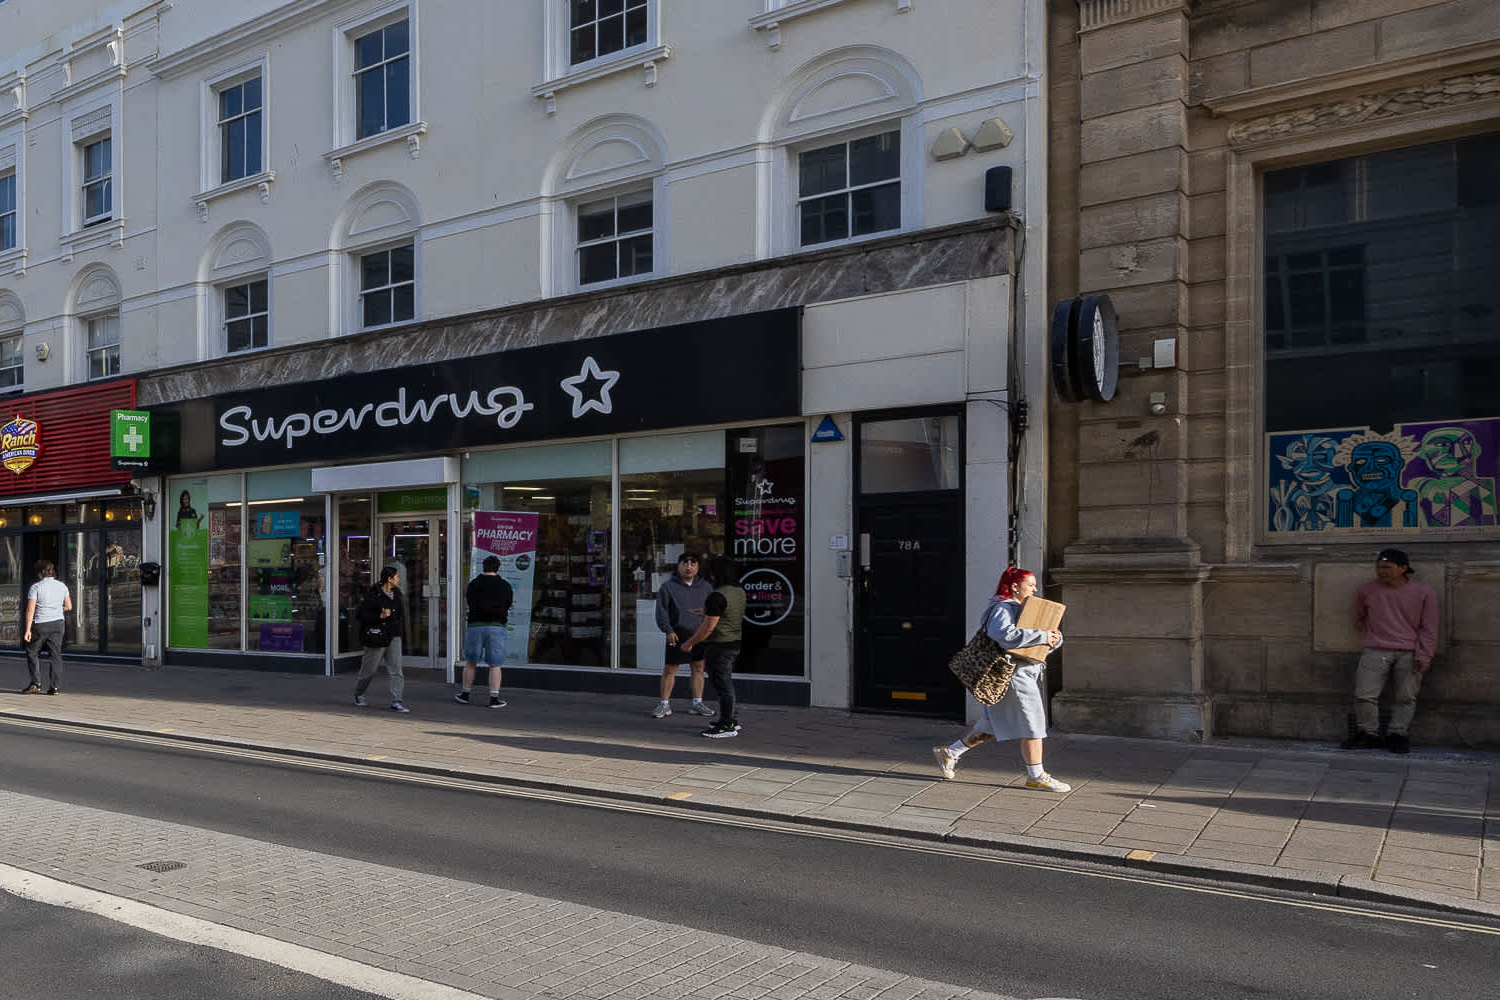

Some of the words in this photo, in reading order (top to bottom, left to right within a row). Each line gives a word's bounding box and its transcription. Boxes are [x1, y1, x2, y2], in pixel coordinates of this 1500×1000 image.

[117, 412, 149, 423] Pharmacy
[219, 386, 534, 449] Superdrug
[1, 430, 36, 450] Ranch
[2, 449, 23, 460] AMERICAN
[734, 497, 796, 505] Superdrug
[734, 517, 797, 535] save
[476, 529, 533, 541] PHARMACY
[734, 537, 796, 555] more
[744, 582, 773, 591] order
[774, 582, 782, 590] &
